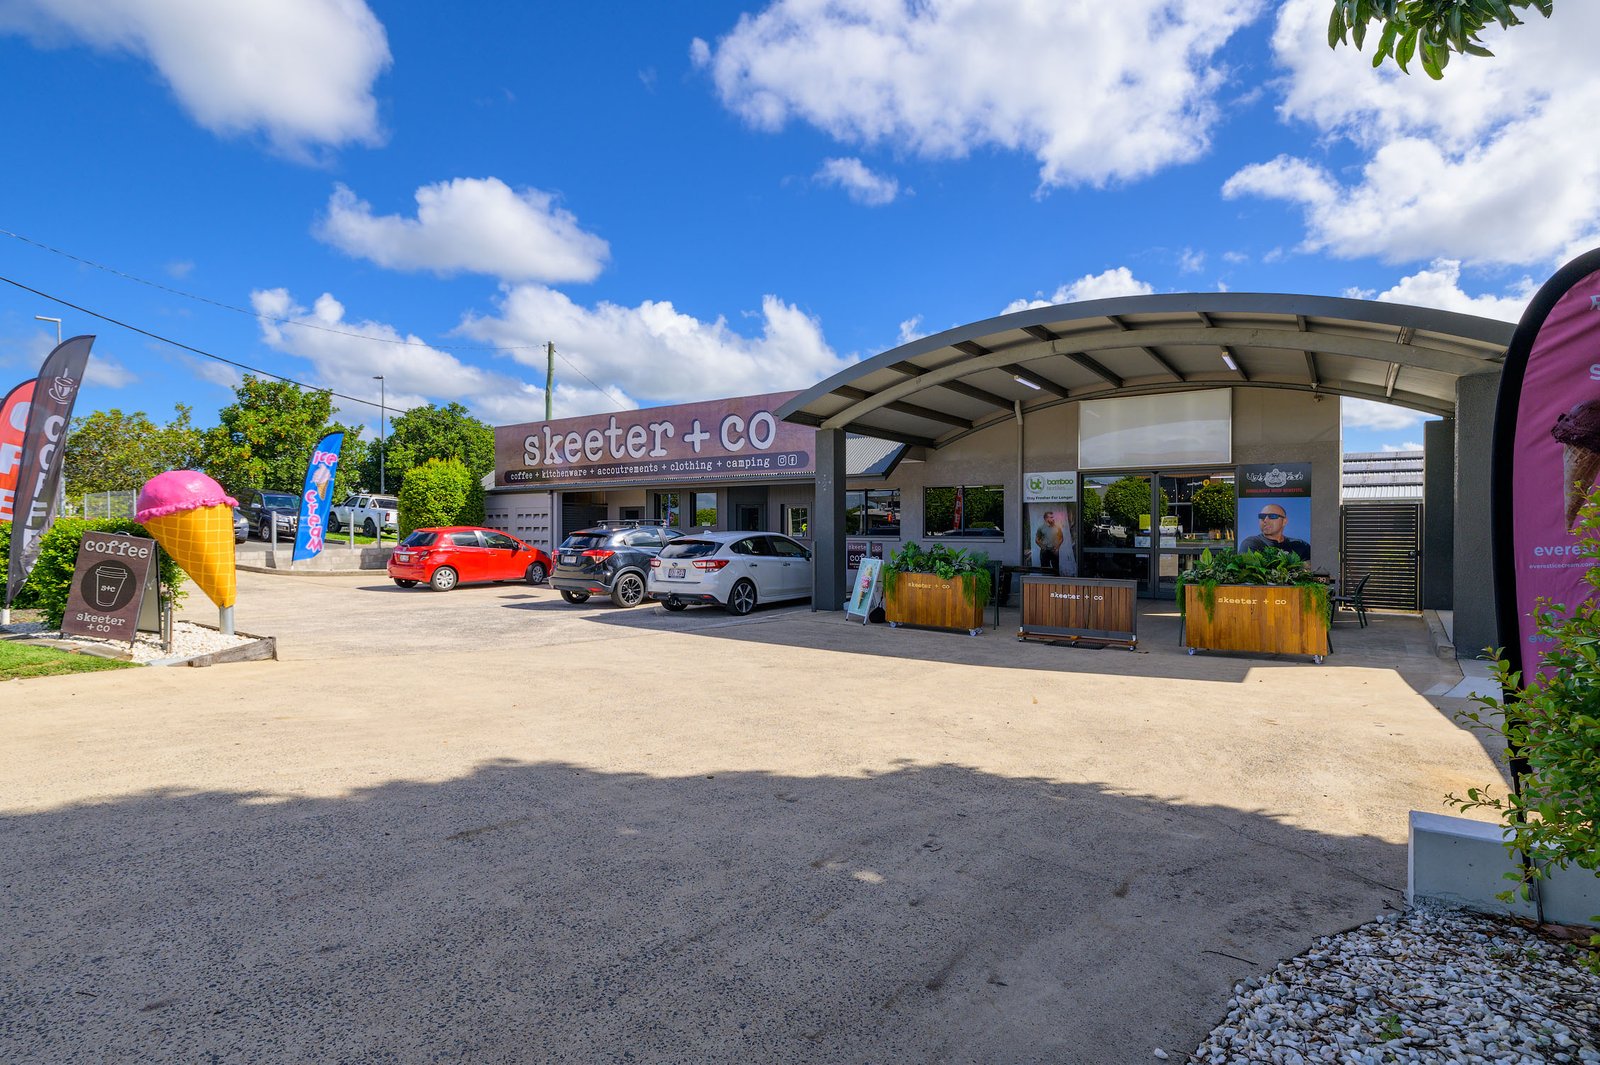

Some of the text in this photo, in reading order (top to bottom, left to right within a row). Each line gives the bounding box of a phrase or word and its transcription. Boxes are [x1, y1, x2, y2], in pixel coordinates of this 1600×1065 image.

[523, 416, 675, 466] skeeter
[684, 419, 711, 452] +
[510, 470, 533, 480] coffee
[541, 468, 587, 479] kitchenware
[597, 463, 658, 476] accoutrements
[670, 460, 713, 472] clothing
[726, 456, 770, 469] camping
[1046, 478, 1074, 486] bamboo
[84, 540, 149, 559] coffee
[908, 581, 932, 589] skeeter
[1049, 591, 1080, 600] skeeter
[1217, 596, 1258, 605] skeeter
[76, 612, 126, 626] skeeter
